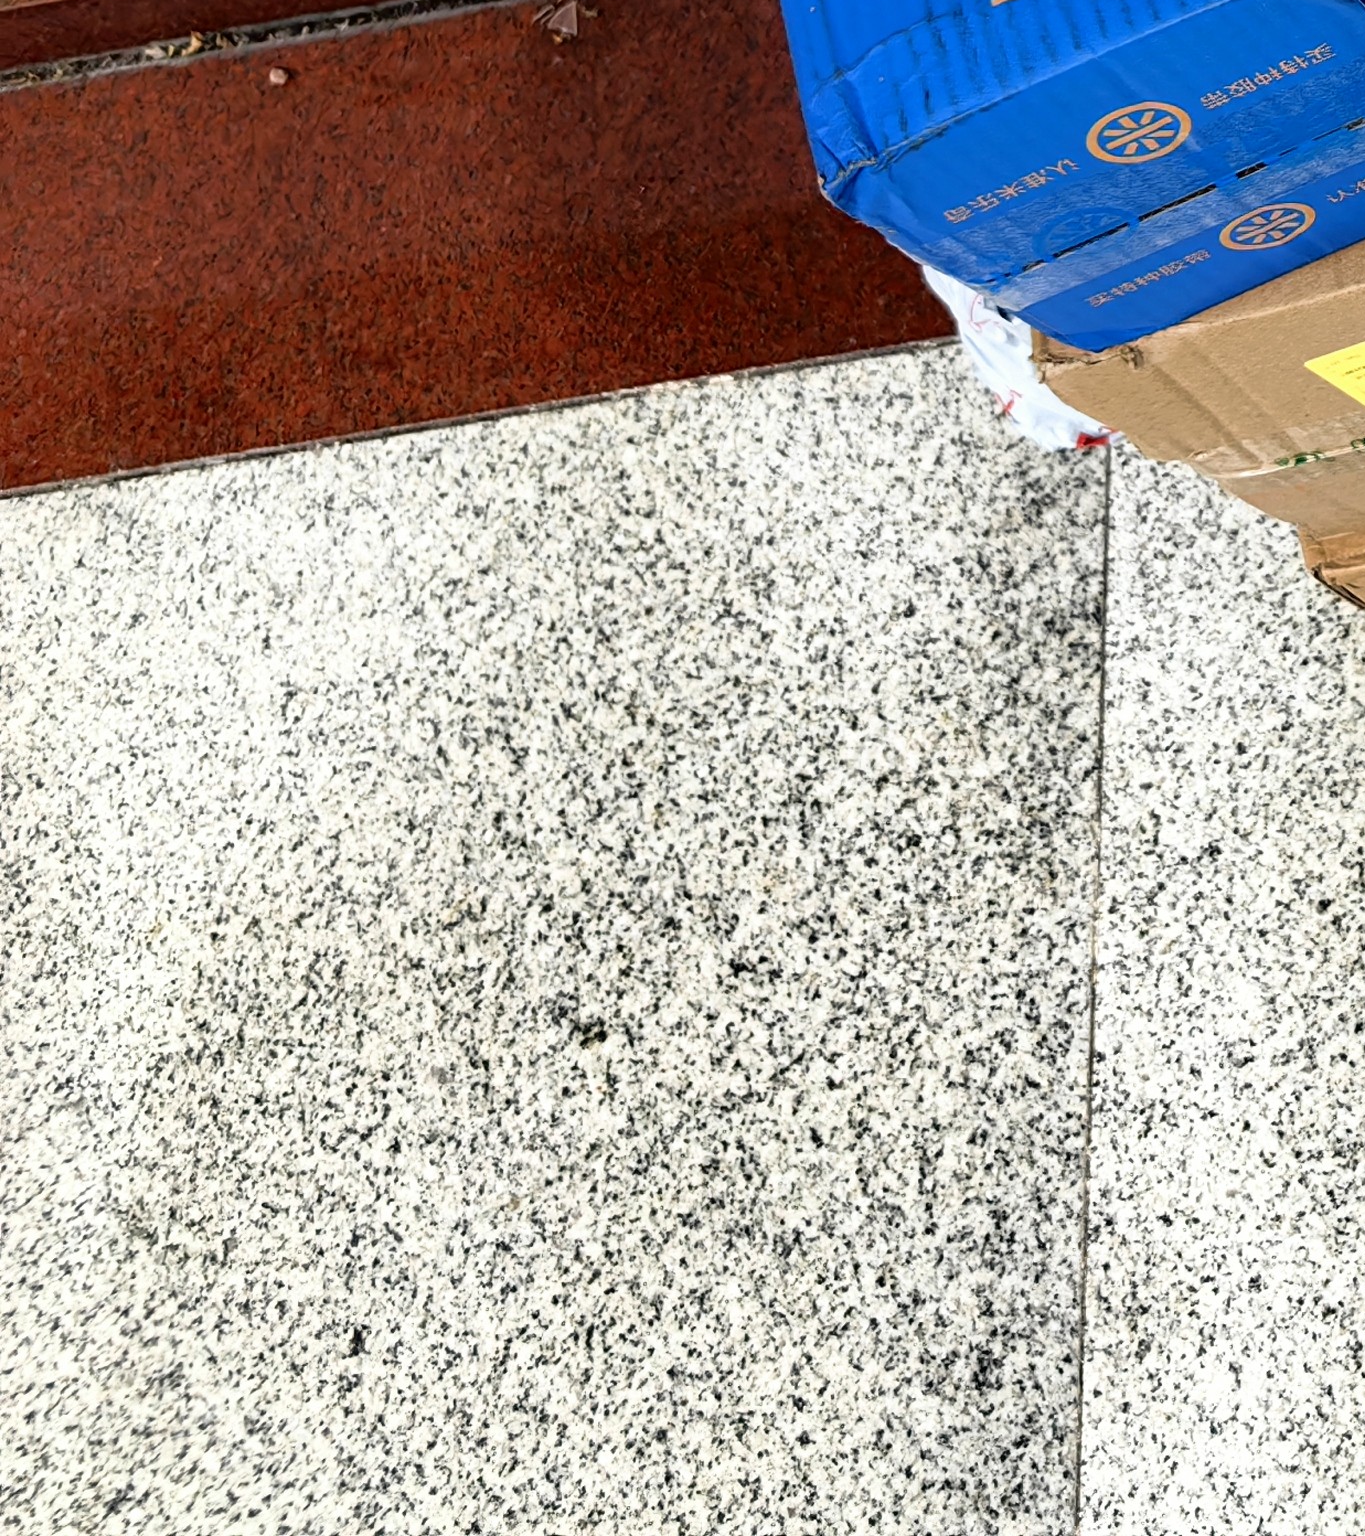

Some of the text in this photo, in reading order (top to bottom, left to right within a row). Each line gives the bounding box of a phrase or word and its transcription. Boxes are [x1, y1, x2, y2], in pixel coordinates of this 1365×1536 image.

[1202, 41, 1337, 111] 买特种胶带
[942, 157, 1077, 226] 认准米乐奇
